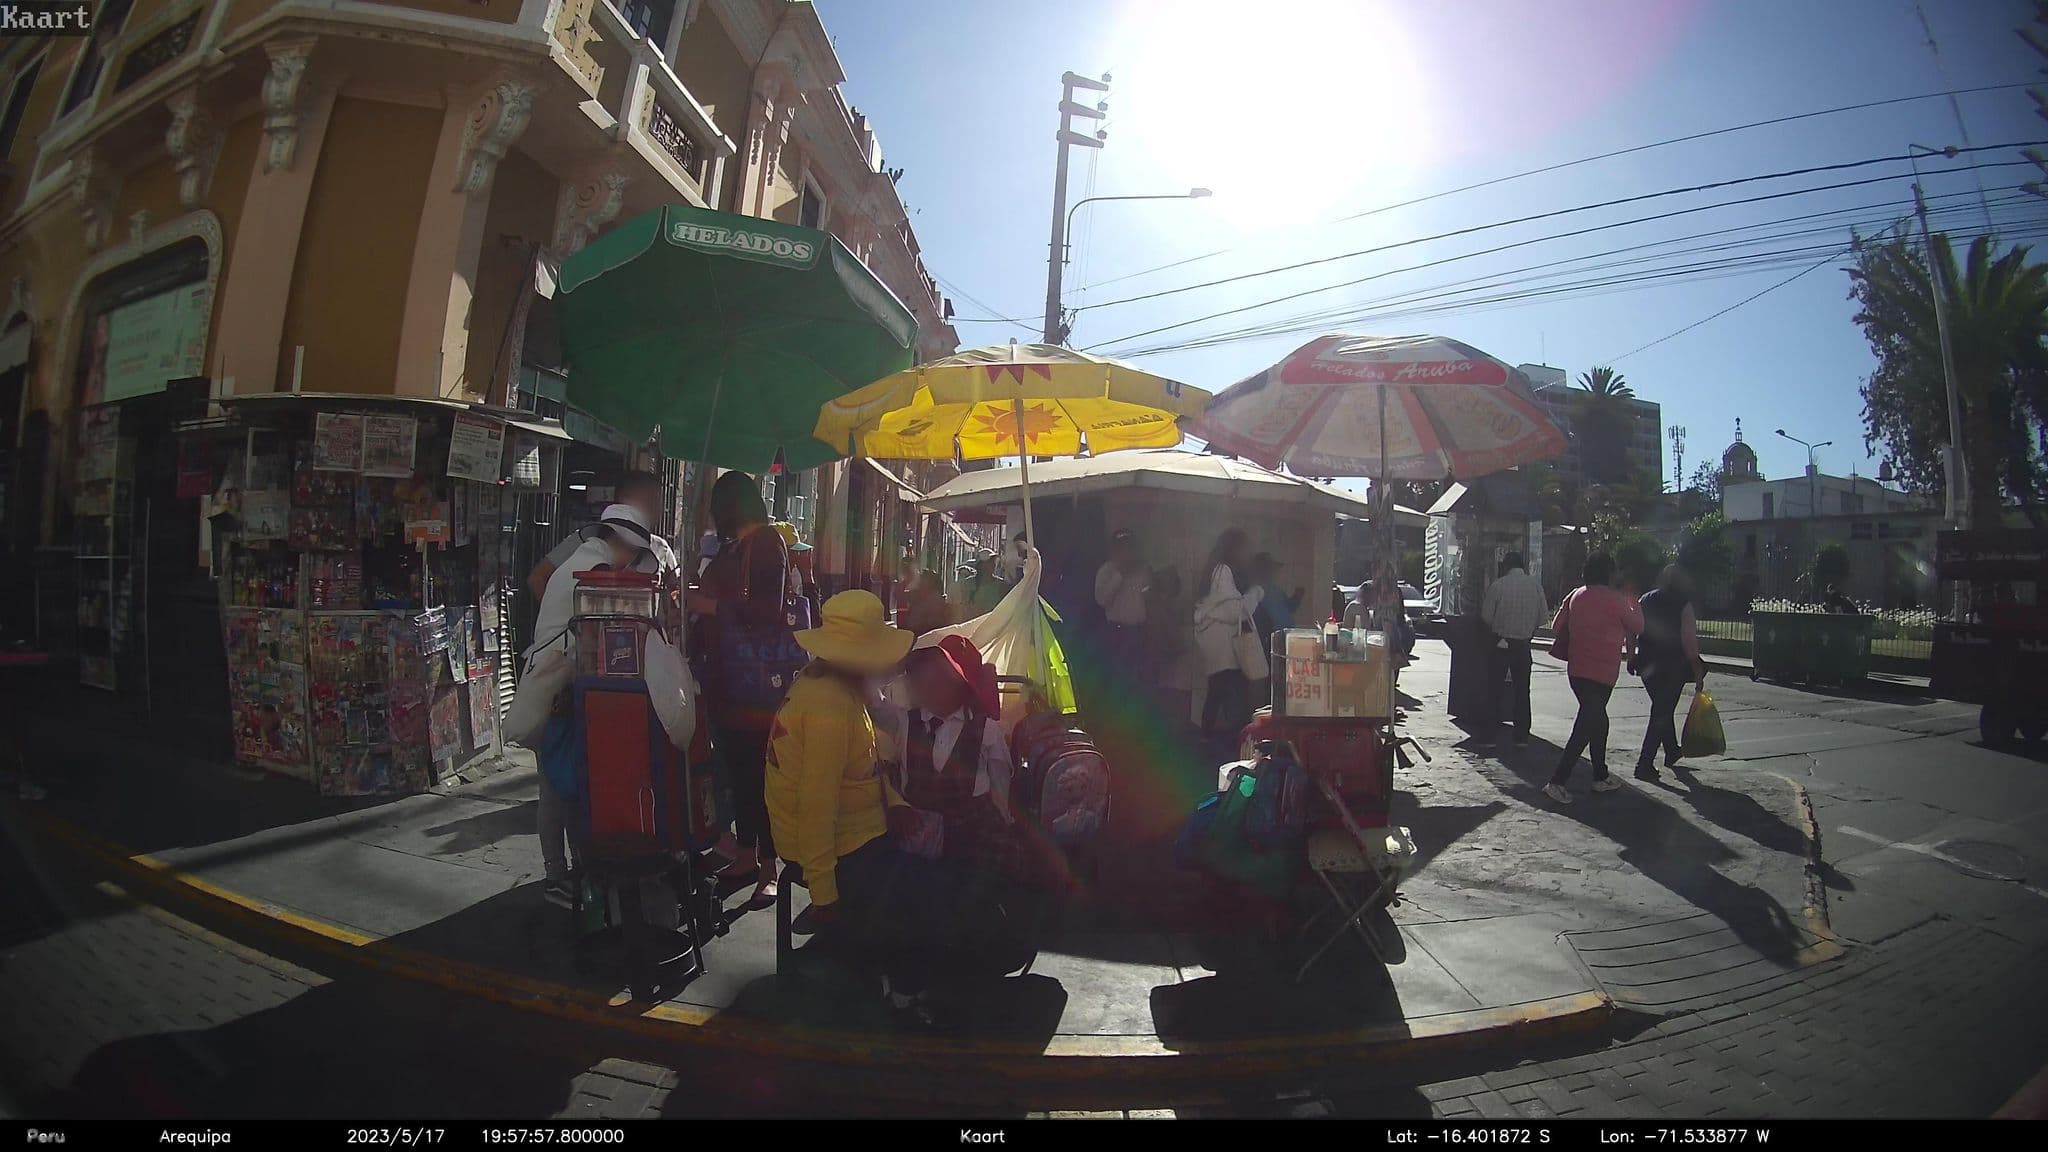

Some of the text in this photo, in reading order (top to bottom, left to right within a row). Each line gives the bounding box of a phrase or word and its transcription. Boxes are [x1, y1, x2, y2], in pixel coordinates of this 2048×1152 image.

[675, 223, 811, 260] HELADOS
[1311, 359, 1474, 382] Helados Aruba
